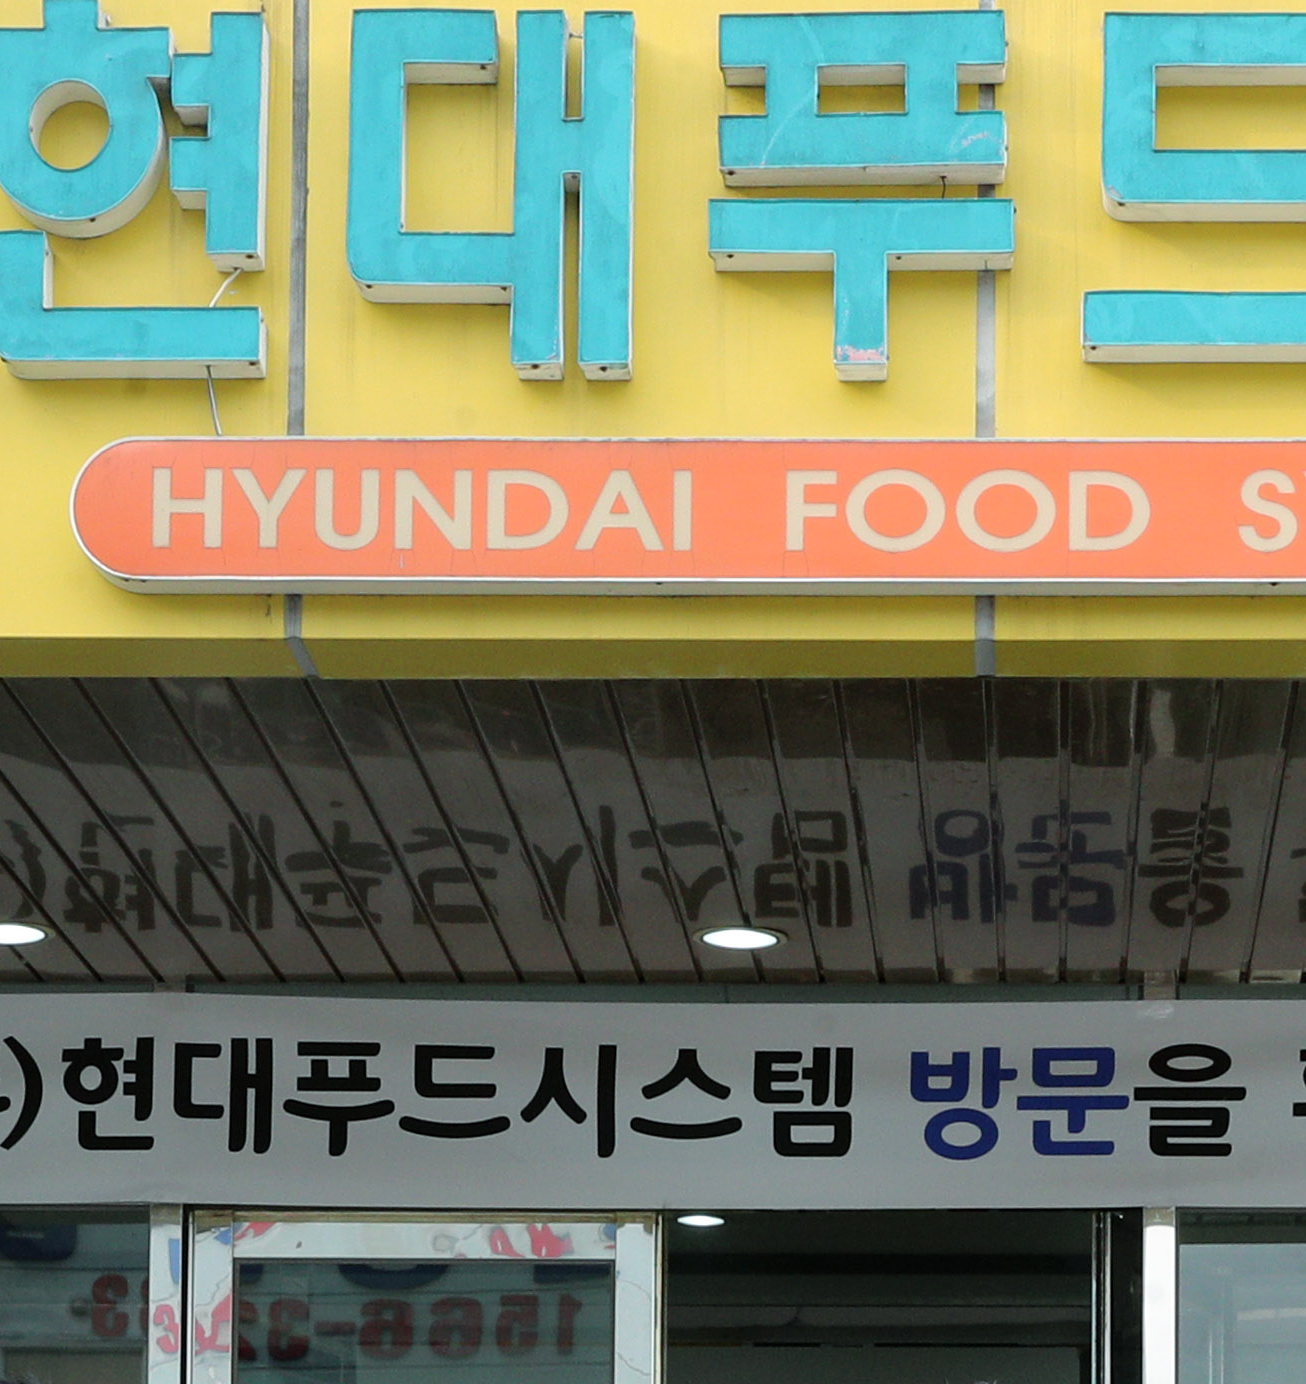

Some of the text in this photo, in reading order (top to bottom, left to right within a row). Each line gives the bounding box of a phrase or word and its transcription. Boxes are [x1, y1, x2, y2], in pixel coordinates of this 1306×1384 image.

[151, 467, 693, 552] HYUNDAI
[785, 468, 1151, 553] FOOD
[910, 1043, 1247, 1160] 방문을
